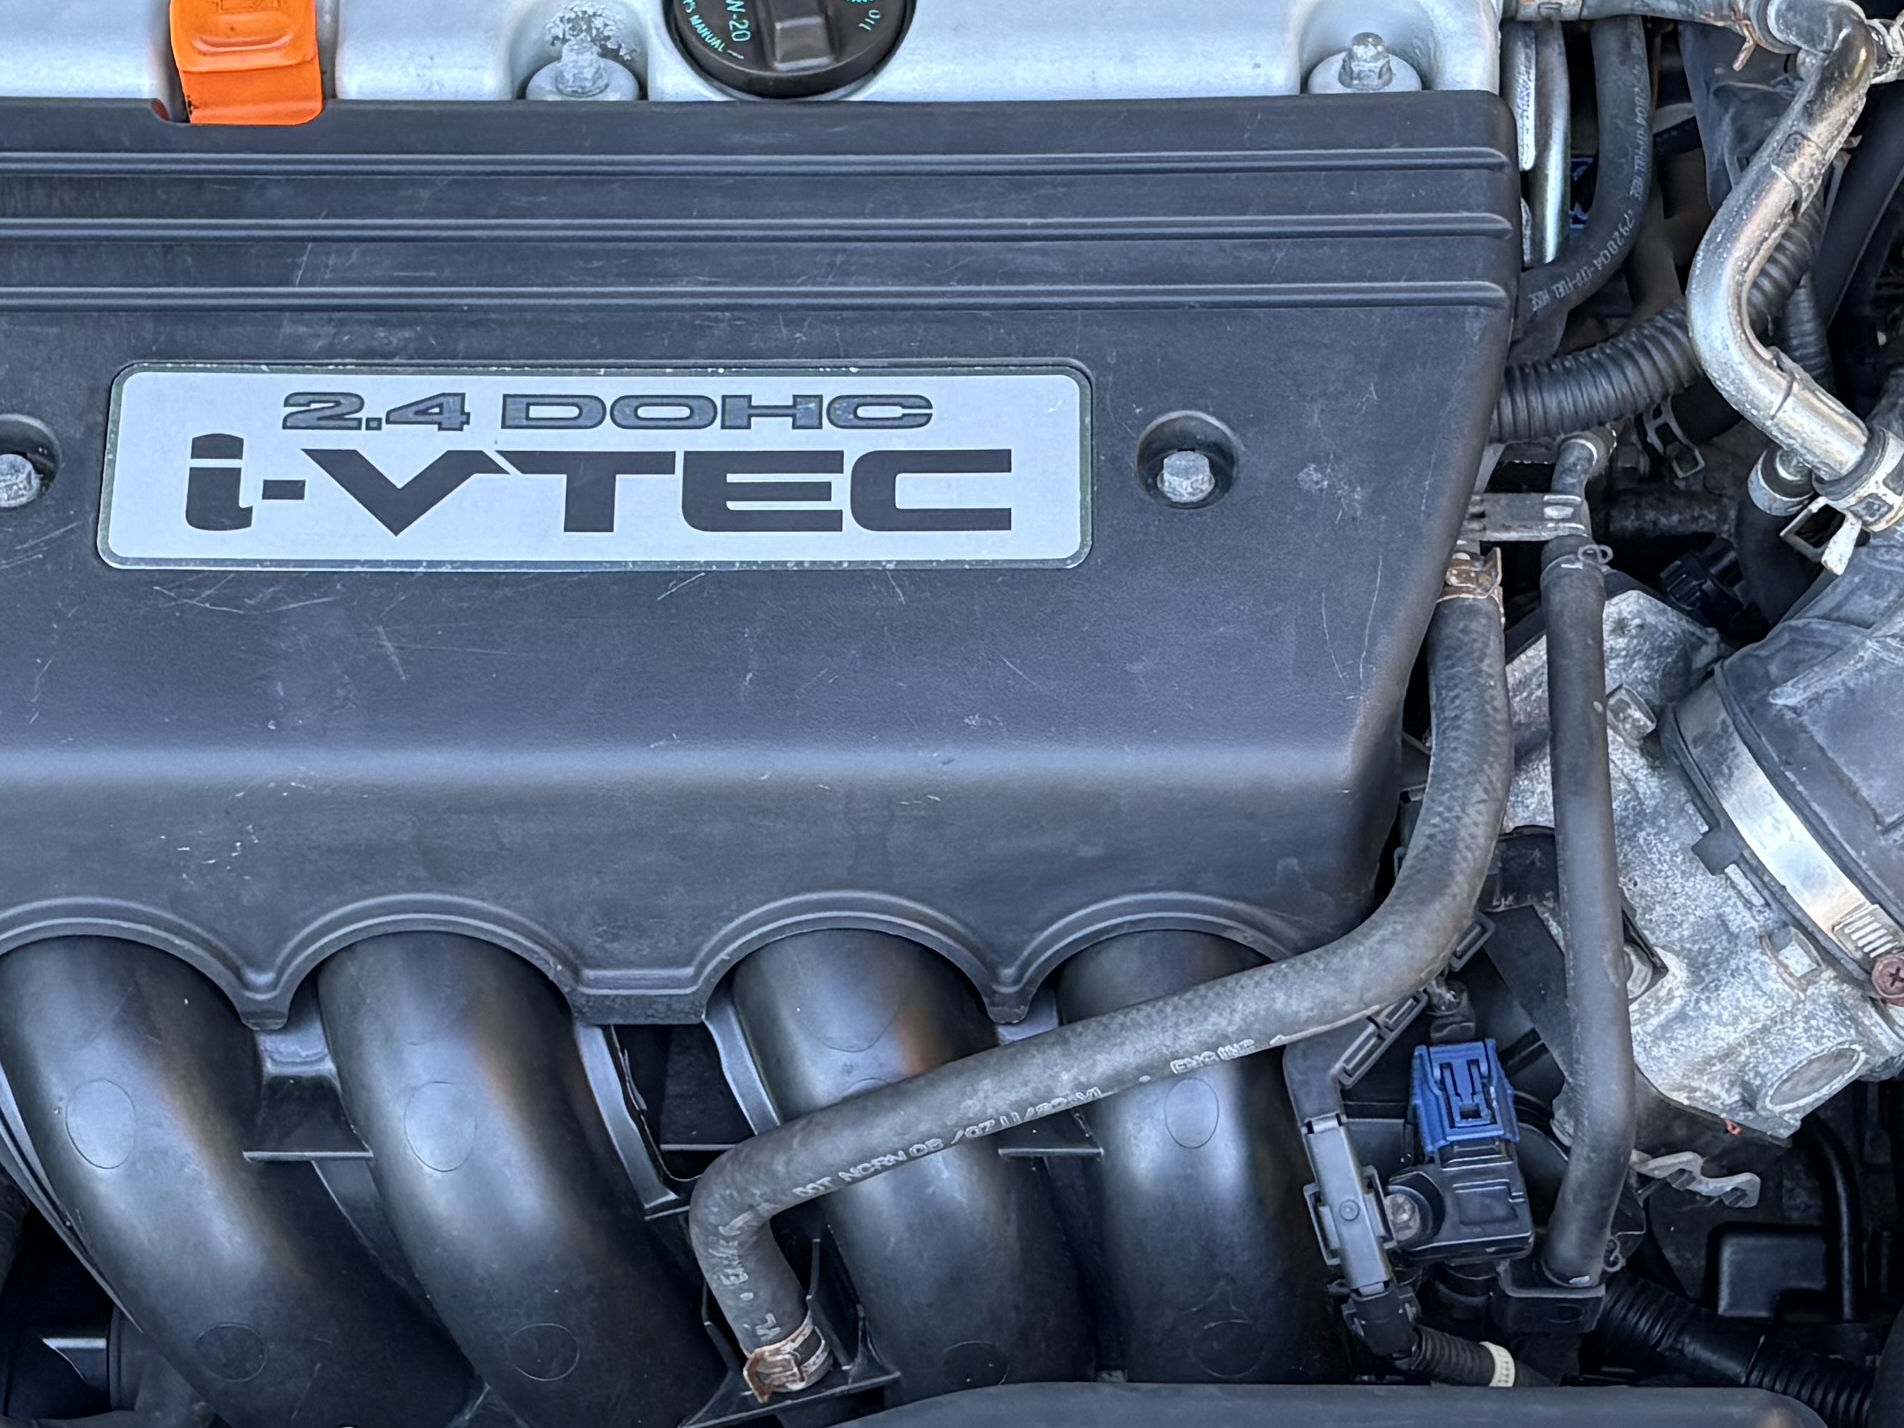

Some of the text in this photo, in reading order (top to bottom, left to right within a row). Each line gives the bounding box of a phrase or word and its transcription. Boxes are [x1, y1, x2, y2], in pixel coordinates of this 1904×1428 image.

[689, 15, 725, 52] MANUAL
[858, 9, 880, 30] OIL
[282, 392, 933, 431] 2.4 DOHC
[185, 432, 1012, 537] i-VTEC
